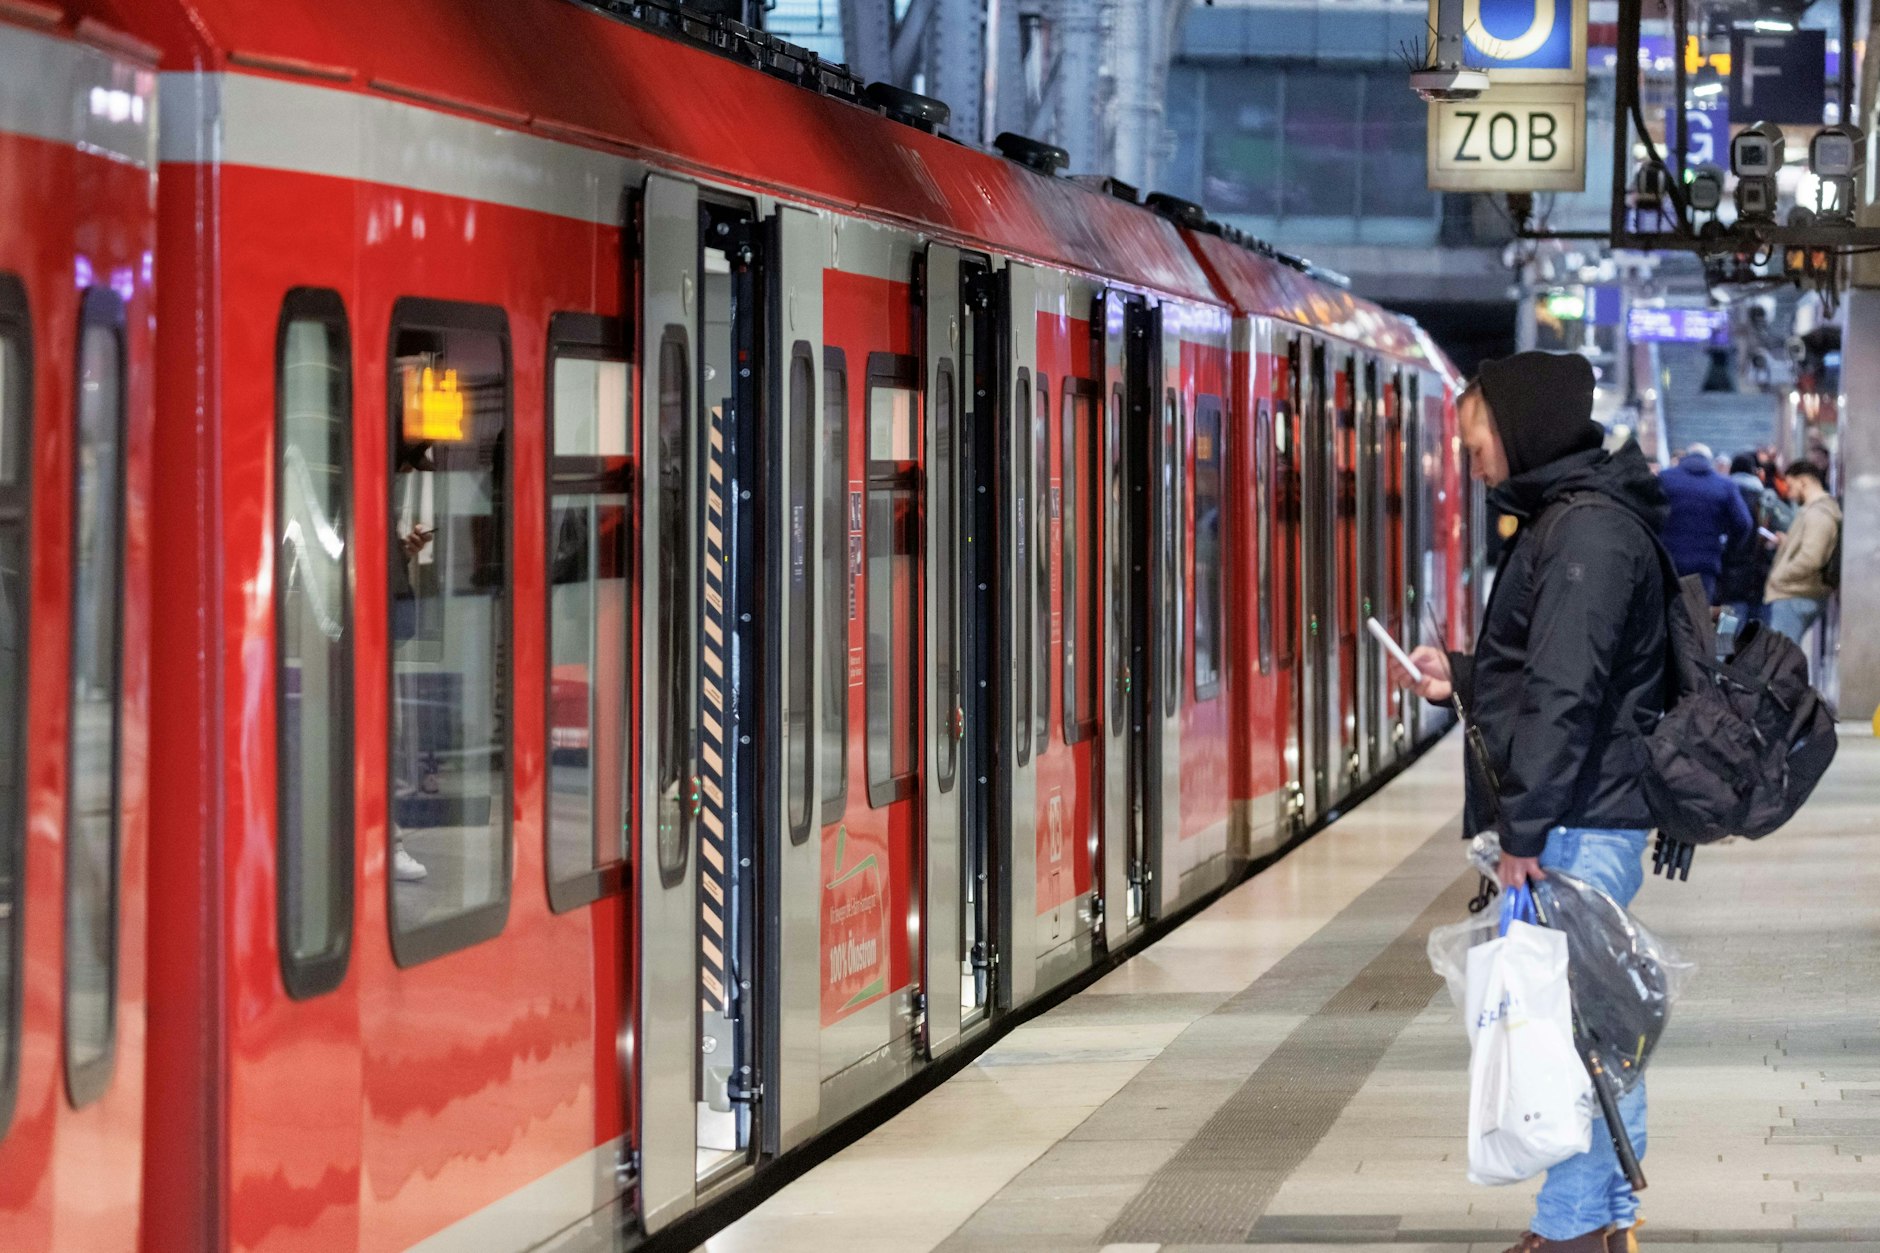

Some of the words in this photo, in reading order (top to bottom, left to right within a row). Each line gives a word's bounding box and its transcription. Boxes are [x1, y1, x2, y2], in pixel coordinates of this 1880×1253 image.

[1742, 37, 1786, 108] F
[1453, 111, 1558, 162] ZOB
[830, 942, 847, 984] 100%
[848, 930, 877, 975] Ökostrom
